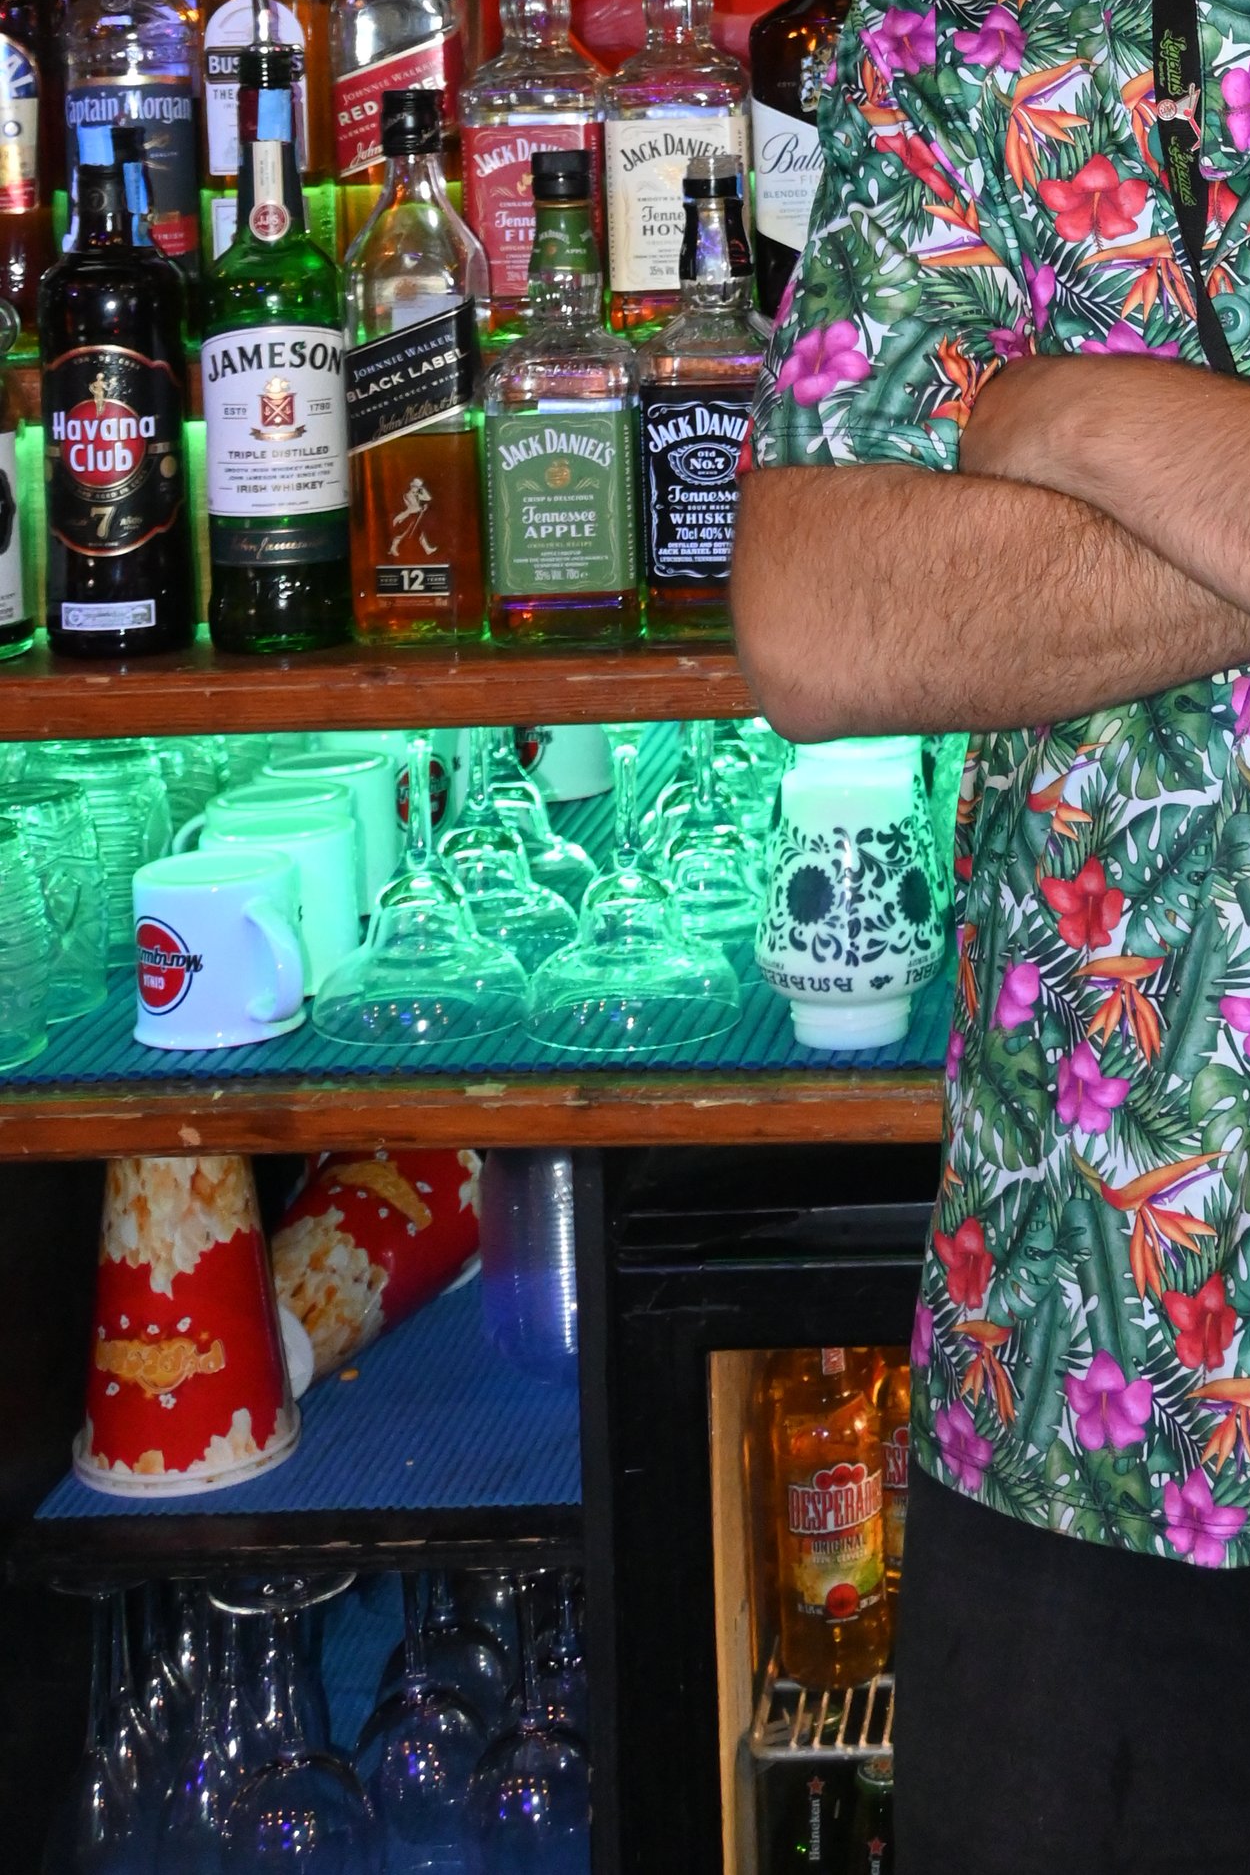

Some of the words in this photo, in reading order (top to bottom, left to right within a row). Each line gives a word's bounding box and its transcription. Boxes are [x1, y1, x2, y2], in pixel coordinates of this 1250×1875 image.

[1160, 29, 1188, 97] Legends
[212, 89, 234, 100] THE
[65, 91, 118, 126] Captain
[118, 89, 193, 125] Morgan
[338, 100, 379, 127] RED
[473, 142, 516, 178] JACK
[621, 138, 661, 172] JACK
[763, 190, 808, 199] BLENDED
[495, 210, 537, 228] Tenne
[641, 205, 685, 223] Tenne
[642, 224, 685, 236] HON
[208, 341, 342, 383] JAMESON
[353, 353, 404, 383] JOHNNIE
[404, 334, 456, 358] WALKER
[345, 371, 405, 403] BLACK
[408, 347, 468, 378] LABEL
[53, 410, 156, 441] Havana
[647, 415, 695, 453] JACK
[695, 407, 749, 443] DANI
[69, 442, 133, 473] Club
[228, 451, 267, 460] TRIPLE
[271, 445, 329, 459] DISTILLED
[498, 435, 544, 471] JACK
[543, 428, 616, 468] DANIEL'S
[697, 450, 716, 458] Old
[689, 457, 725, 471] No.7
[236, 484, 267, 494] IRISH
[271, 480, 324, 492] WHISKEY
[667, 485, 740, 504] Tennesse
[89, 506, 117, 537] 7
[521, 505, 597, 524] Tennessee
[669, 513, 735, 525] WHISKE
[524, 524, 597, 538] APPLE
[675, 527, 698, 540] 70cl
[699, 527, 723, 540] 40%
[400, 569, 425, 591] 12
[808, 1797, 822, 1862] Heineken
